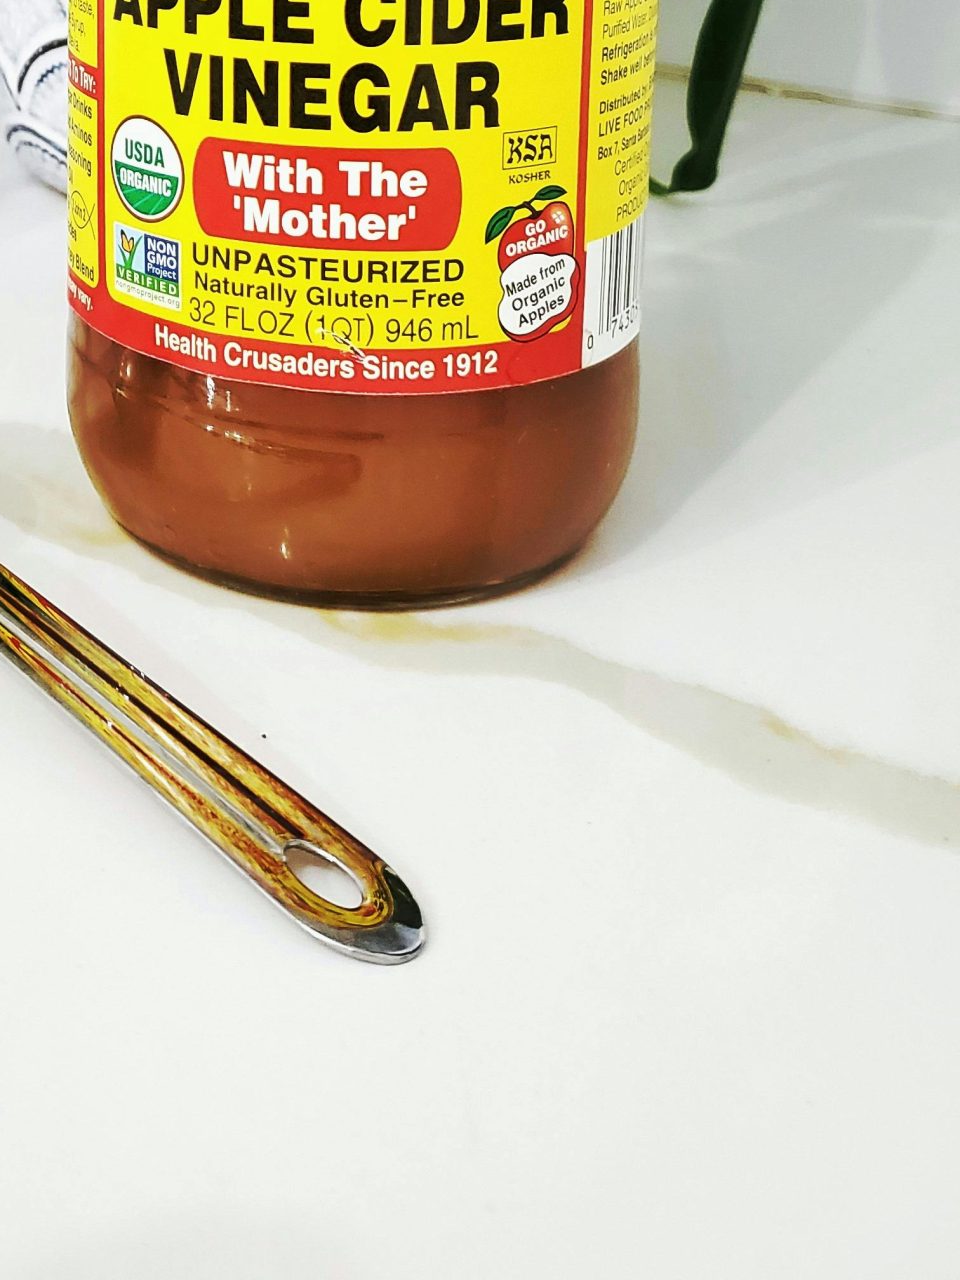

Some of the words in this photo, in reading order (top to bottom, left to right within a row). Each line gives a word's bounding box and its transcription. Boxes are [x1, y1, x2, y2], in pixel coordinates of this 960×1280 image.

[603, 0, 622, 17] Raw
[602, 20, 630, 41] Purified
[163, 48, 501, 133] VINEGAR
[599, 64, 628, 87] Shake
[599, 88, 641, 116] Distributed
[598, 115, 621, 139] LIVE
[622, 104, 644, 132] FOOD
[124, 137, 165, 169] USDA
[507, 133, 553, 164] KSA
[597, 144, 613, 162] Box
[120, 166, 172, 199] ORGANIC
[222, 150, 324, 196] With
[338, 160, 428, 198] The
[508, 169, 551, 185] KOSHER
[233, 195, 416, 241] 'Mother'
[524, 220, 546, 237] GO
[147, 237, 177, 258] NON
[505, 224, 569, 258] ORGANIC
[146, 253, 177, 270] GMO
[147, 262, 177, 281] Project
[192, 242, 465, 284] UNPASTEURIZED
[506, 273, 538, 298] Made
[539, 257, 566, 281] from
[115, 278, 181, 310] nongmoproject.org
[118, 266, 177, 296] VERIFIED
[194, 271, 298, 308] Naturally
[511, 275, 566, 312] Organic
[189, 297, 216, 327] 32
[386, 319, 434, 344] 946
[441, 314, 480, 340] mL
[518, 293, 565, 328] Apples
[153, 323, 218, 364] Health
[224, 341, 355, 378] Crusaders
[363, 354, 436, 381] Since
[442, 350, 499, 377] 1912
[587, 333, 594, 350] 0
